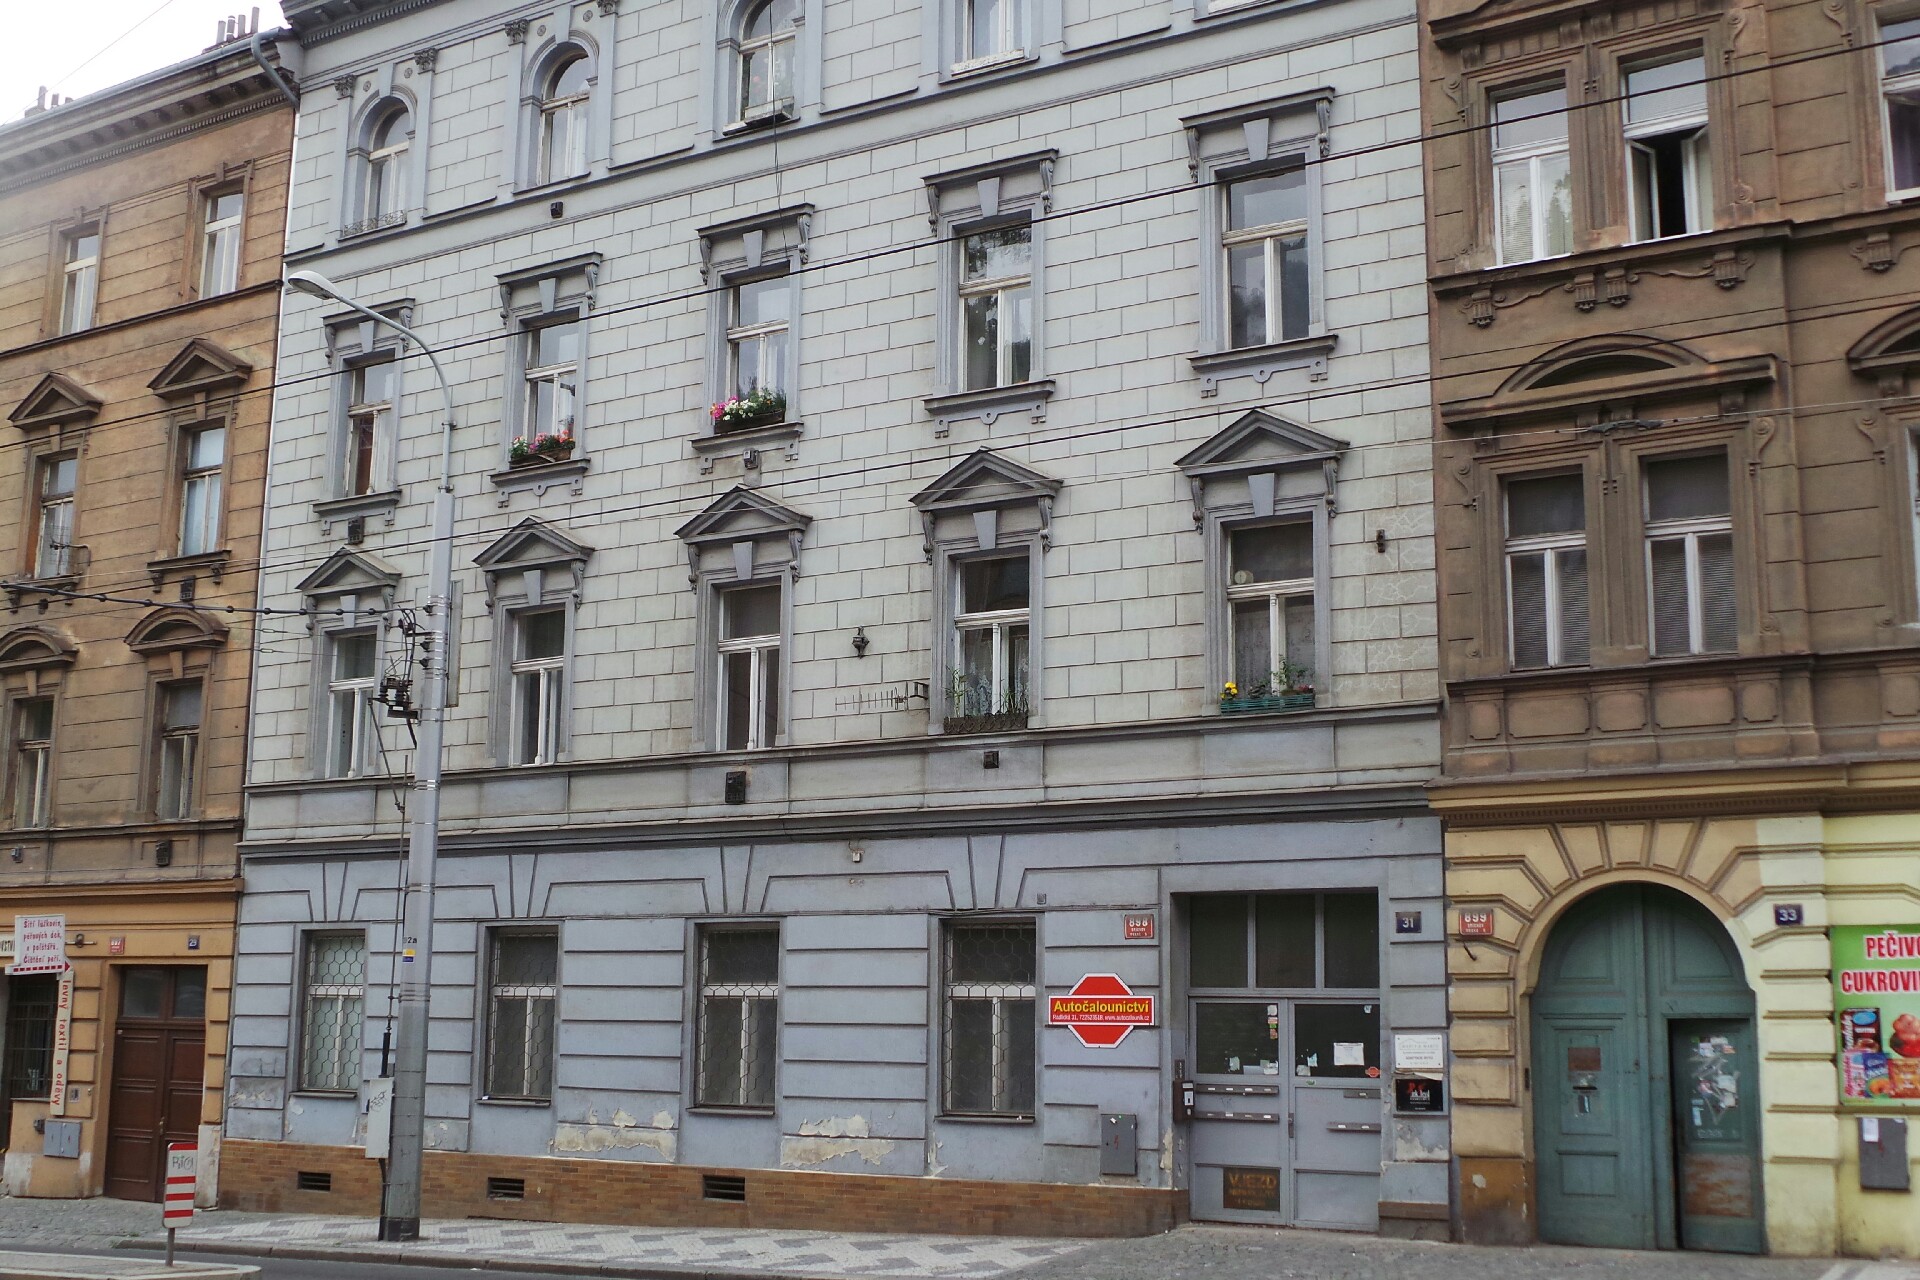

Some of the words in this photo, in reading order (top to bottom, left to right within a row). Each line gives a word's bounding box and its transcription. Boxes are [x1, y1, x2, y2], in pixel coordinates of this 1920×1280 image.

[1464, 912, 1487, 923] 899
[1779, 909, 1797, 921] 33
[1402, 917, 1414, 928] 31
[1841, 971, 1920, 993] CUKROVI
[1053, 1000, 1149, 1012] Autočalounictví
[57, 1018, 67, 1051] textil
